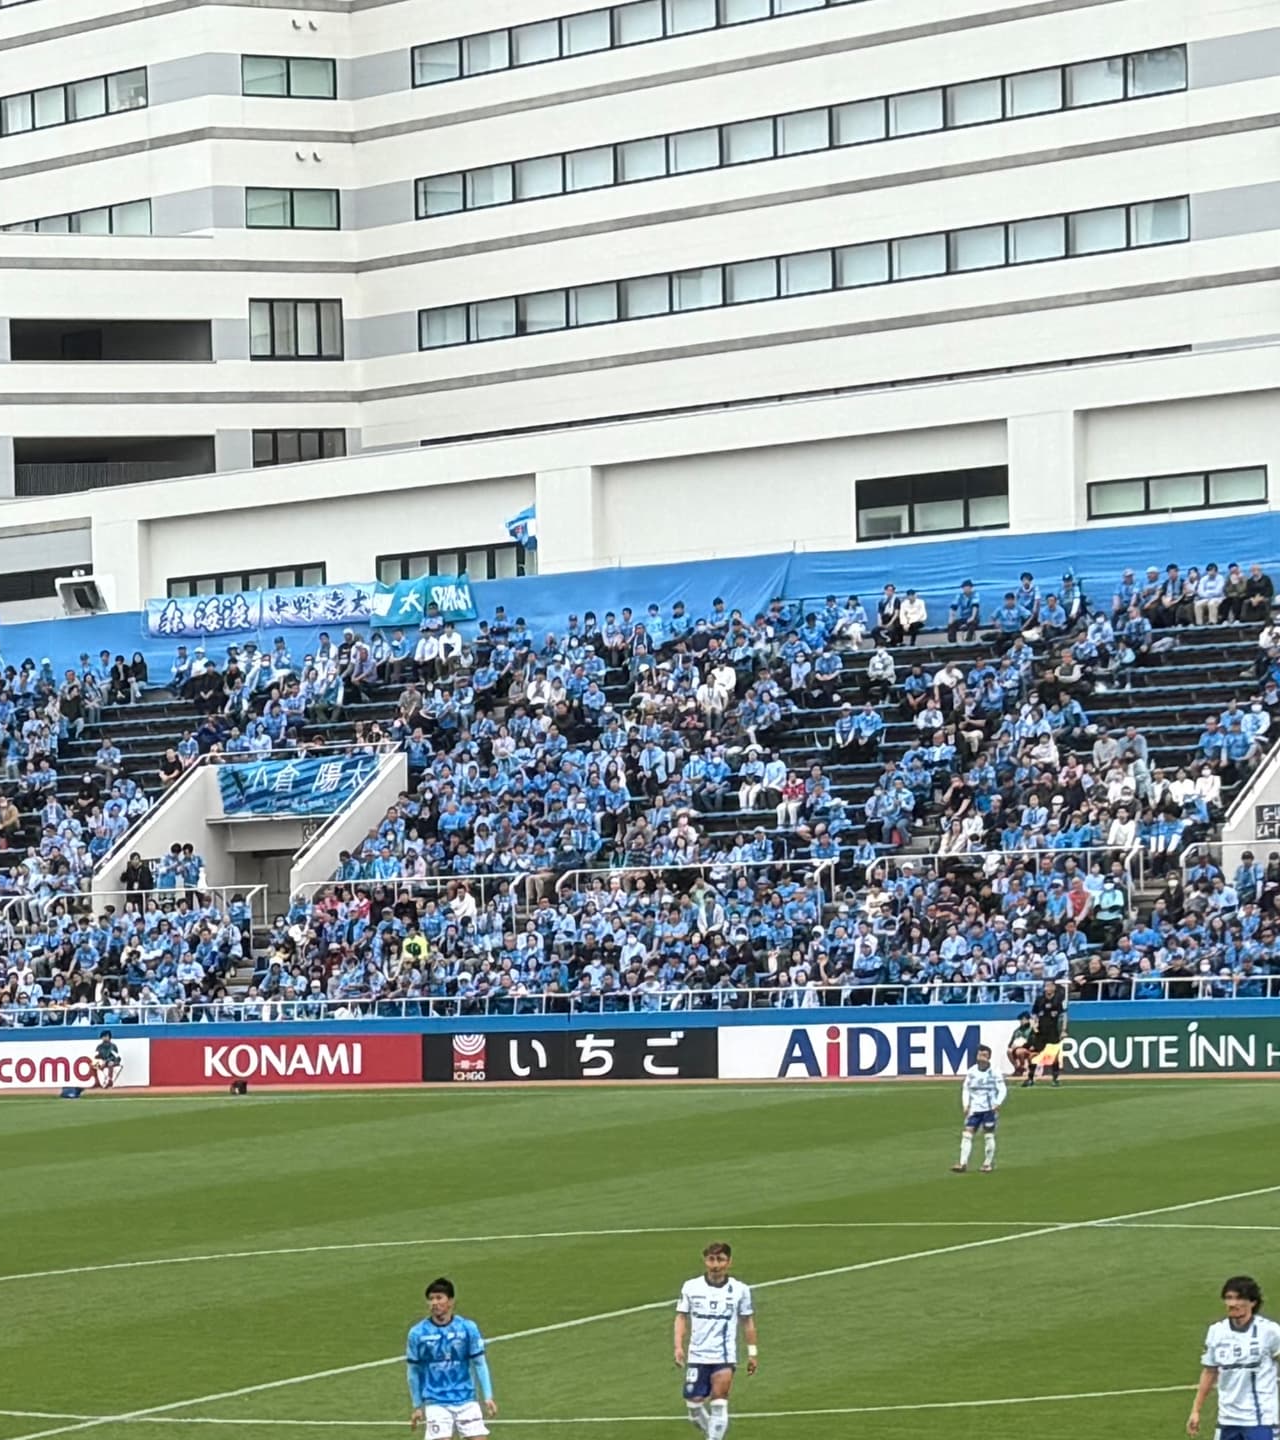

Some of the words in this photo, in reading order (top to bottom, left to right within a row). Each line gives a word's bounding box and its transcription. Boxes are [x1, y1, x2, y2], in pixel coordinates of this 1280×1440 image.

[246, 764, 301, 793] 小倉
[203, 1042, 362, 1078] KONAMI
[508, 1031, 686, 1077] いちご
[1059, 1035, 1179, 1070] ROUTE
[452, 1071, 486, 1081] ICHIGO
